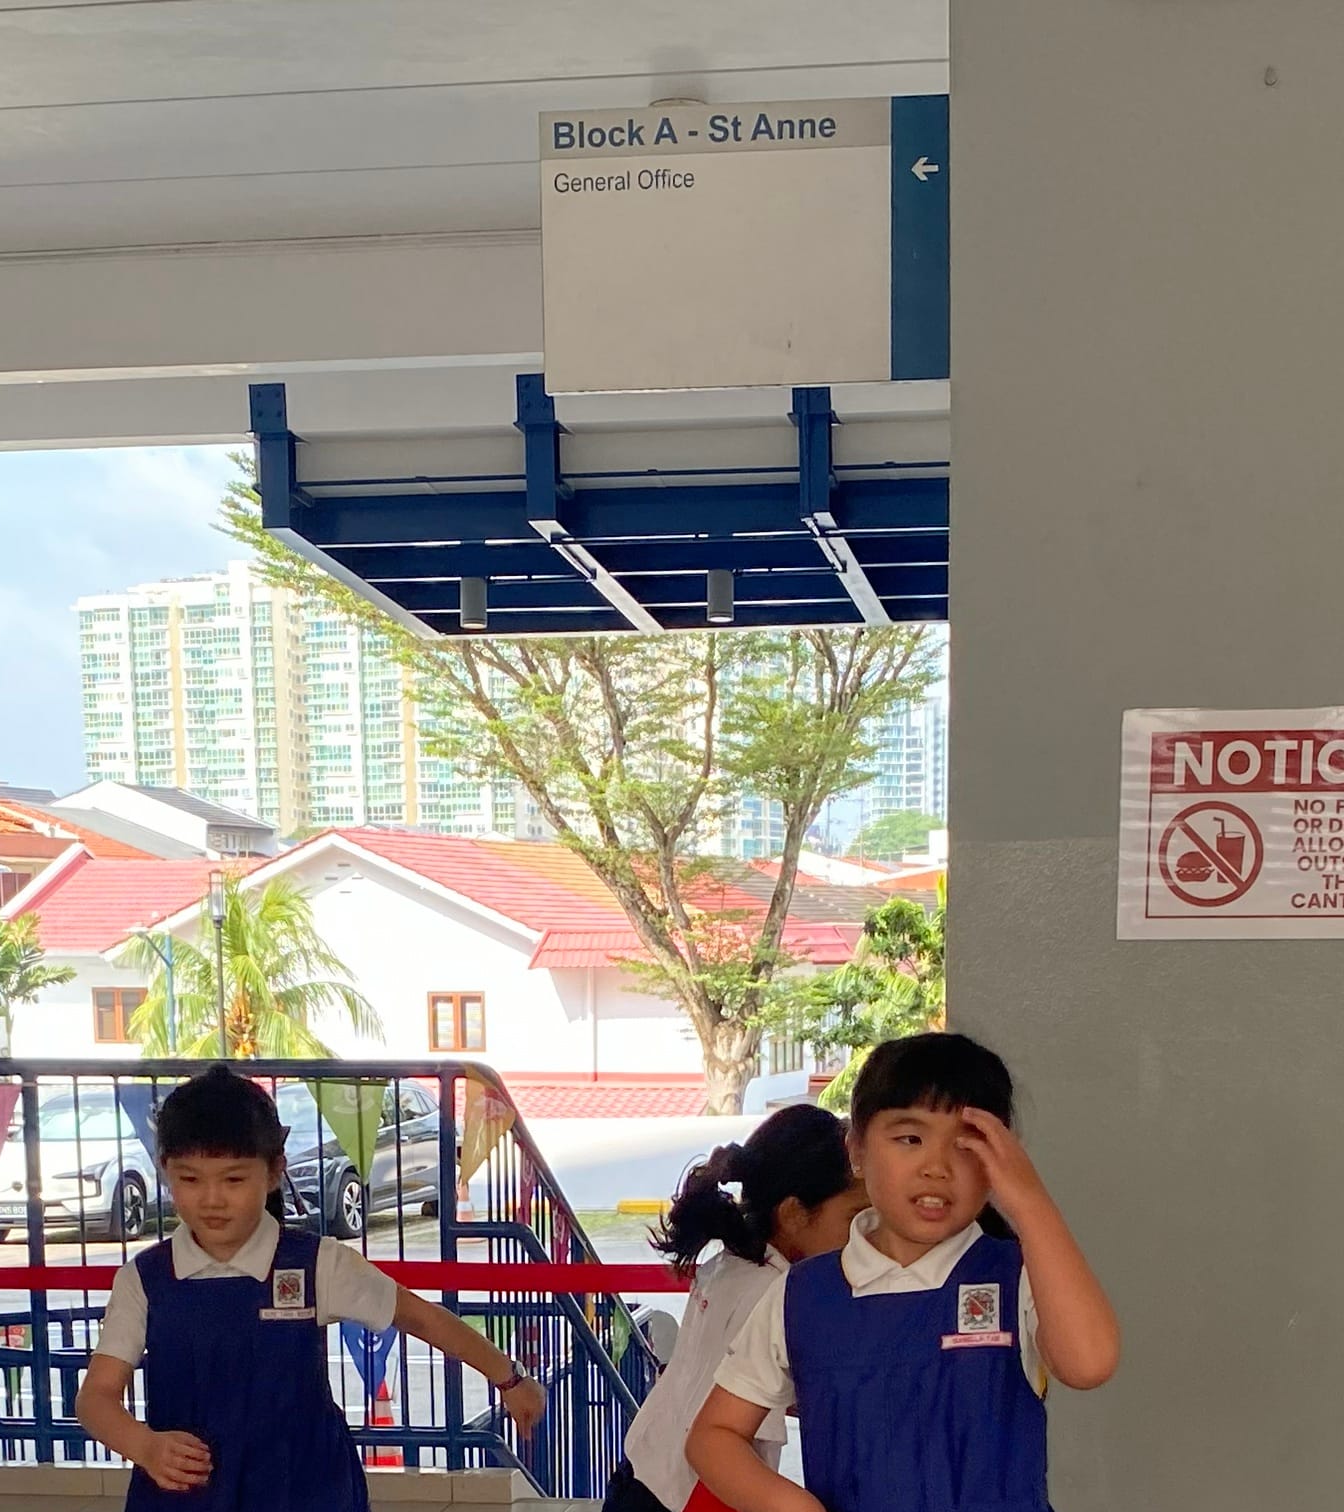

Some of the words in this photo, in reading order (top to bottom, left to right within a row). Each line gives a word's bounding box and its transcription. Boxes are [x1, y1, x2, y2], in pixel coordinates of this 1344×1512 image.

[553, 119, 645, 150] Block
[654, 117, 678, 145] A
[708, 114, 742, 143] St
[750, 113, 836, 141] Anne
[553, 170, 630, 193] General
[638, 168, 695, 190] Office
[1293, 799, 1325, 815] NO
[1293, 818, 1322, 833] OR
